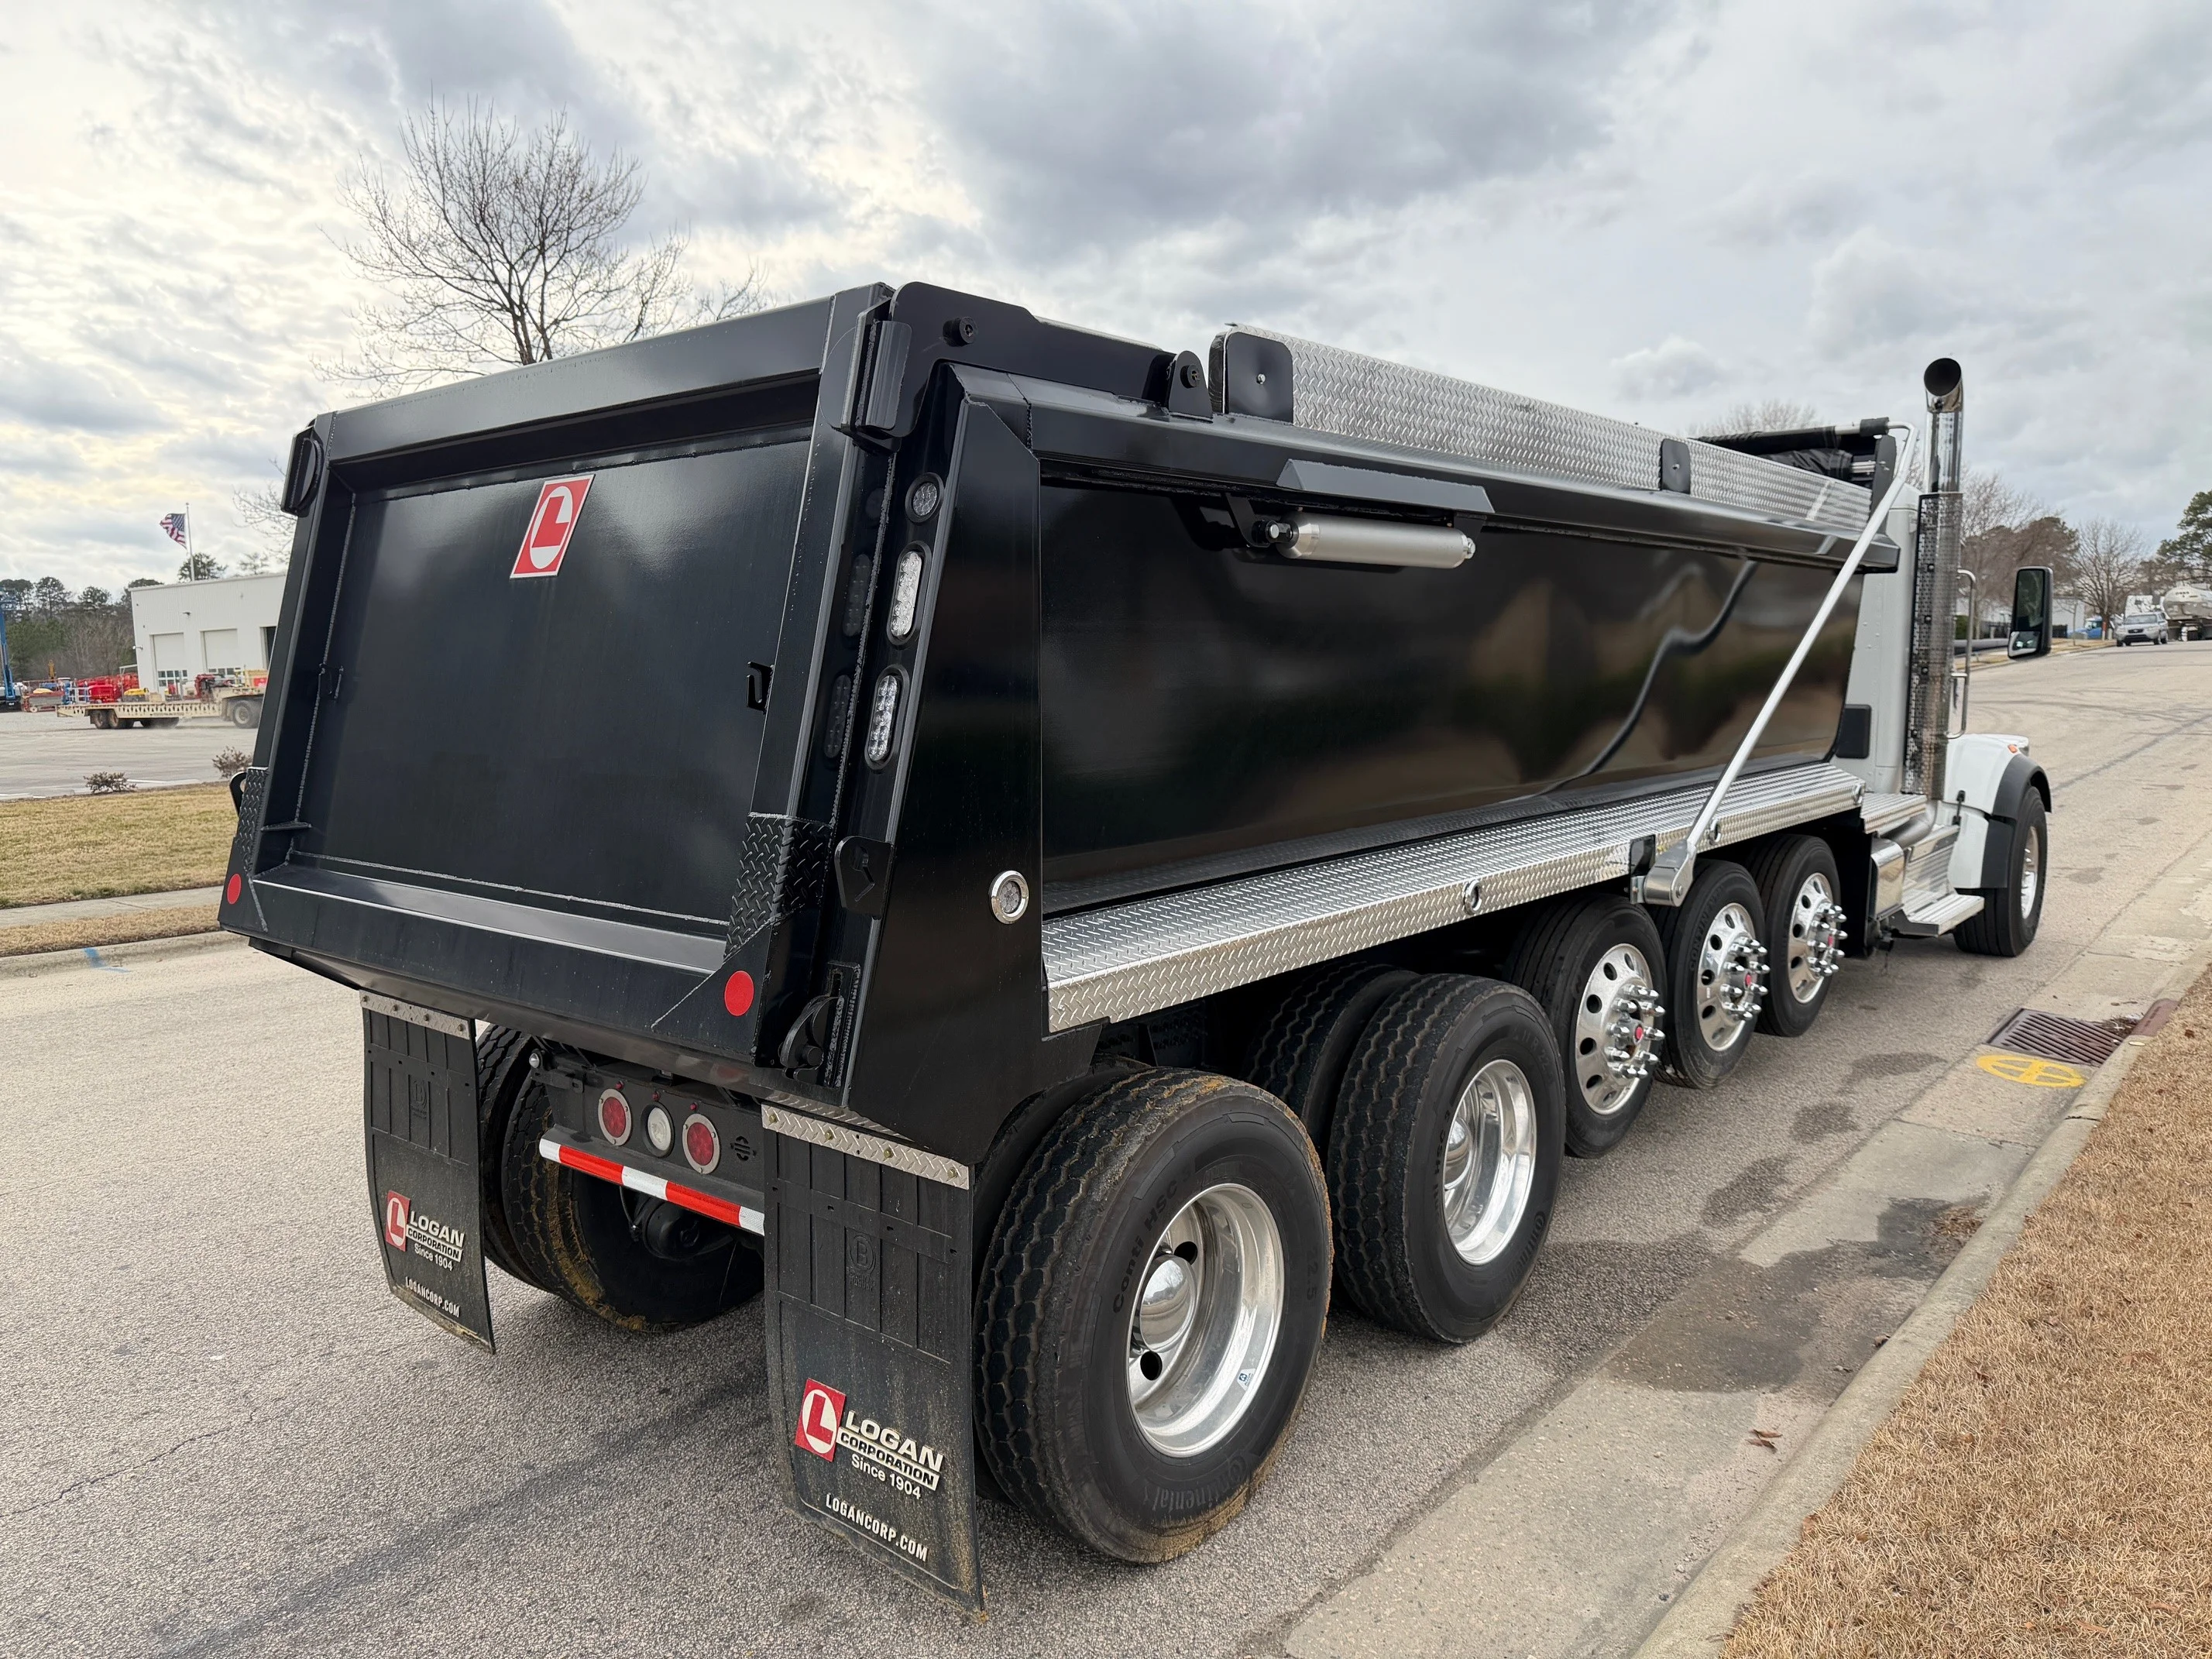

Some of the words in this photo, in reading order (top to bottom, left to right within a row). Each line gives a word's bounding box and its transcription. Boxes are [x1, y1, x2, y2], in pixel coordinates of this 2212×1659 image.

[531, 496, 571, 548] L
[407, 1228, 460, 1259] CORPORATION
[410, 1211, 465, 1248] LOGAN
[1112, 1235, 1145, 1314] Conti
[1144, 1178, 1178, 1231] HSC
[414, 1242, 434, 1261] Since
[434, 1254, 453, 1271] 1904
[405, 1276, 461, 1318] LOGANCORP.COM
[840, 1431, 936, 1488] CORPORATION
[845, 1410, 944, 1472] LOGAN
[851, 1453, 886, 1482] Since
[889, 1472, 922, 1499] 1904
[826, 1492, 929, 1562] LOGANCORP.COM
